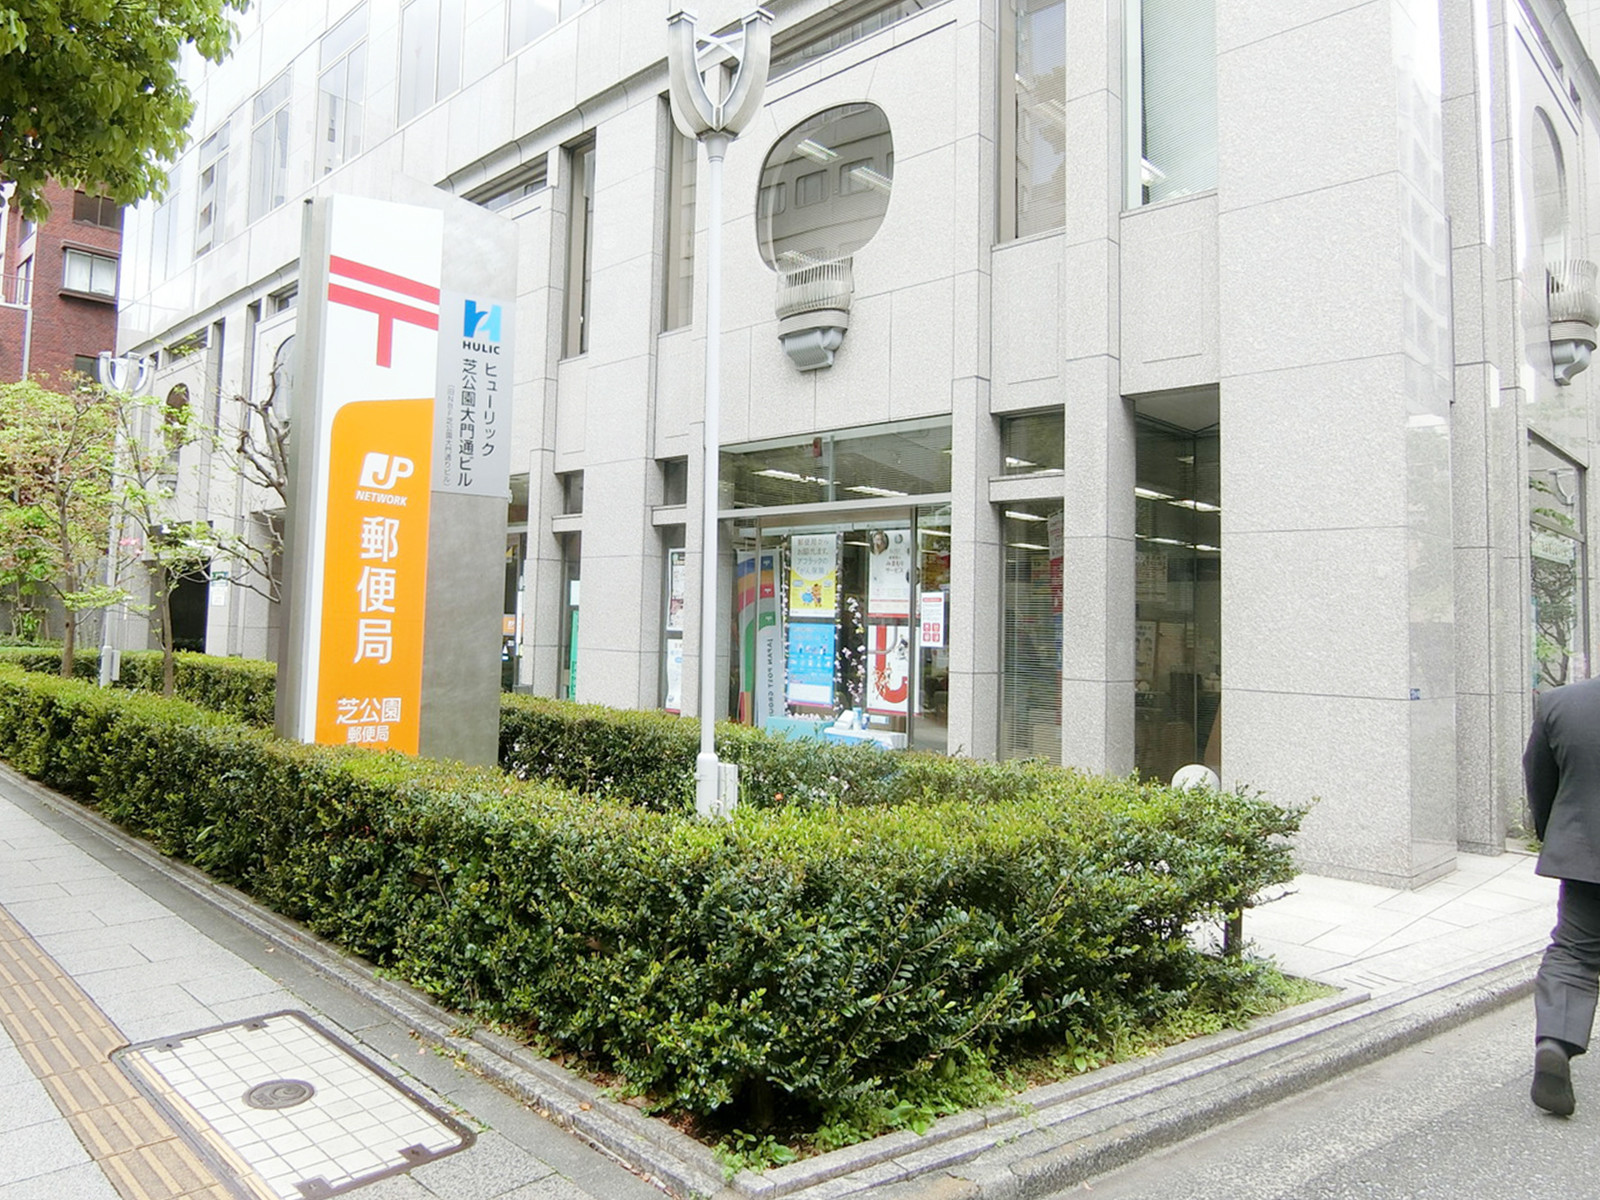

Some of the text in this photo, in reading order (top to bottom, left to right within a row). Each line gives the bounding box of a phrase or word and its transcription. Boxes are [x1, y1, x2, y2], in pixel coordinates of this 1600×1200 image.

[462, 340, 501, 355] HULIC
[457, 358, 478, 487] 芝公園大門通ビル
[481, 362, 498, 457] ヒューリック
[359, 452, 415, 490] JP
[355, 490, 408, 507] NETWORK
[353, 516, 400, 665] 郵便局
[336, 697, 402, 724] 芝公園
[346, 725, 390, 743] 郵便局
